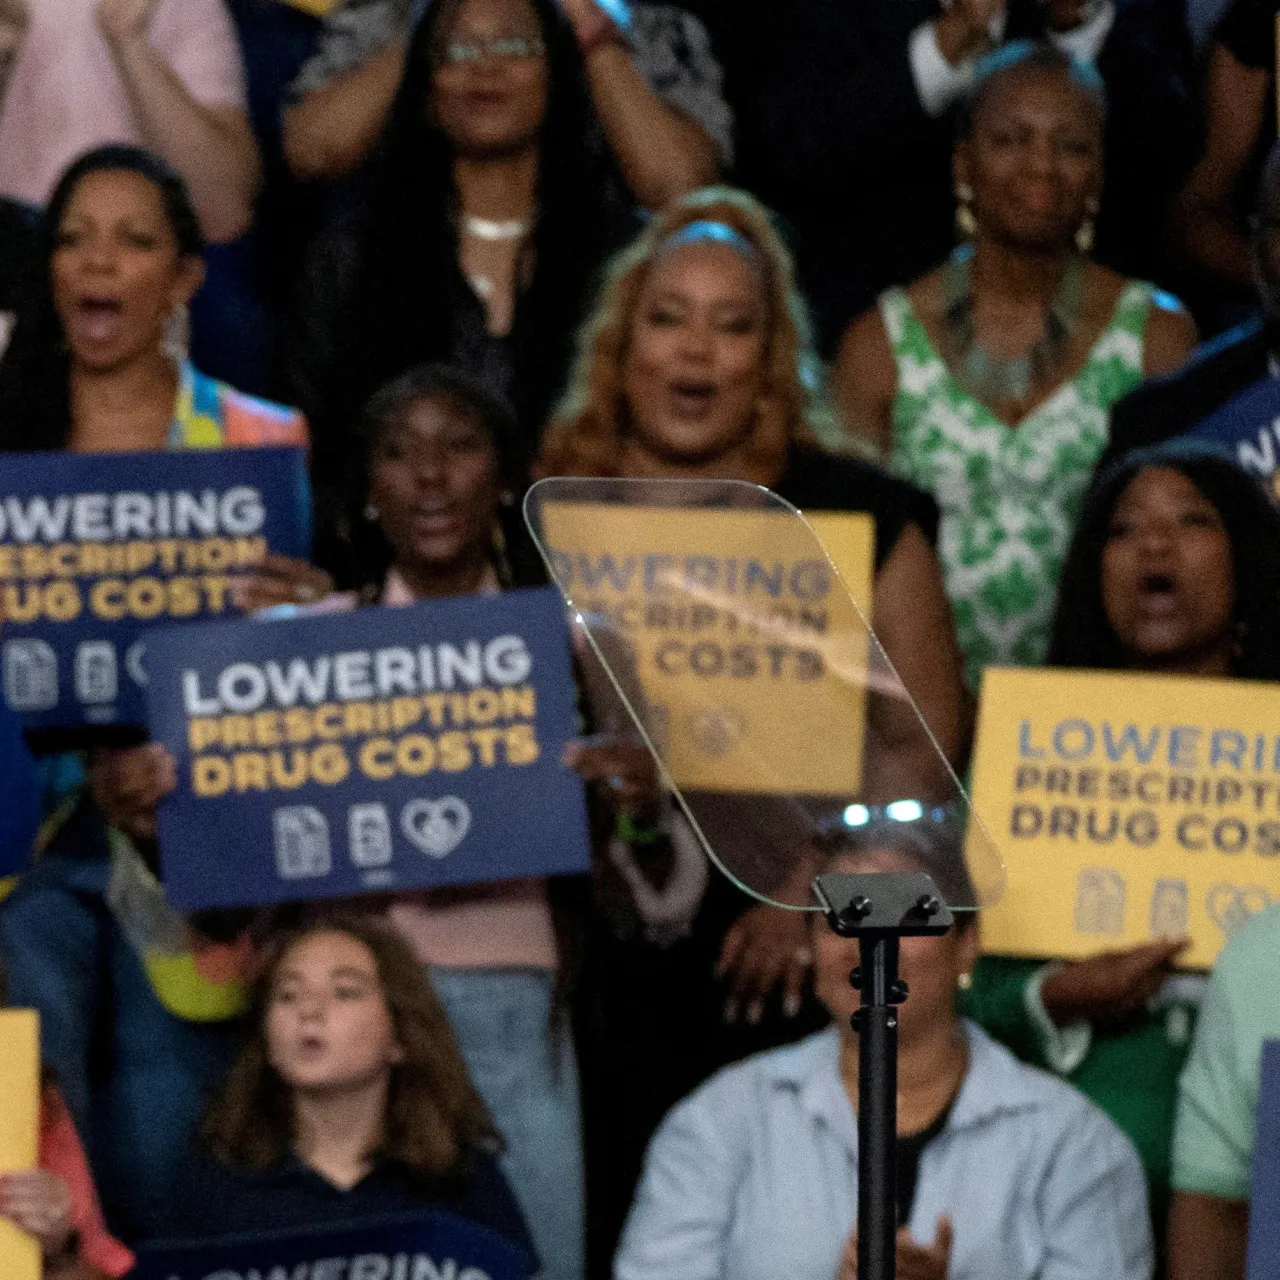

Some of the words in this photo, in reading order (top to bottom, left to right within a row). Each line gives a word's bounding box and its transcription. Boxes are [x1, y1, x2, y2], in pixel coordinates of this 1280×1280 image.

[4, 580, 82, 623] UG
[89, 572, 235, 621] COST
[182, 634, 533, 716] LOWERING
[653, 637, 827, 681] COSTS
[187, 685, 536, 751] PRESCRIPTION
[1017, 717, 1280, 775] LOWERI
[192, 743, 350, 797] DRUG
[358, 723, 540, 780] COSTS
[1013, 763, 1280, 814] PRESCRIPT
[1008, 804, 1162, 849] DRUG
[1174, 811, 1280, 859] COS
